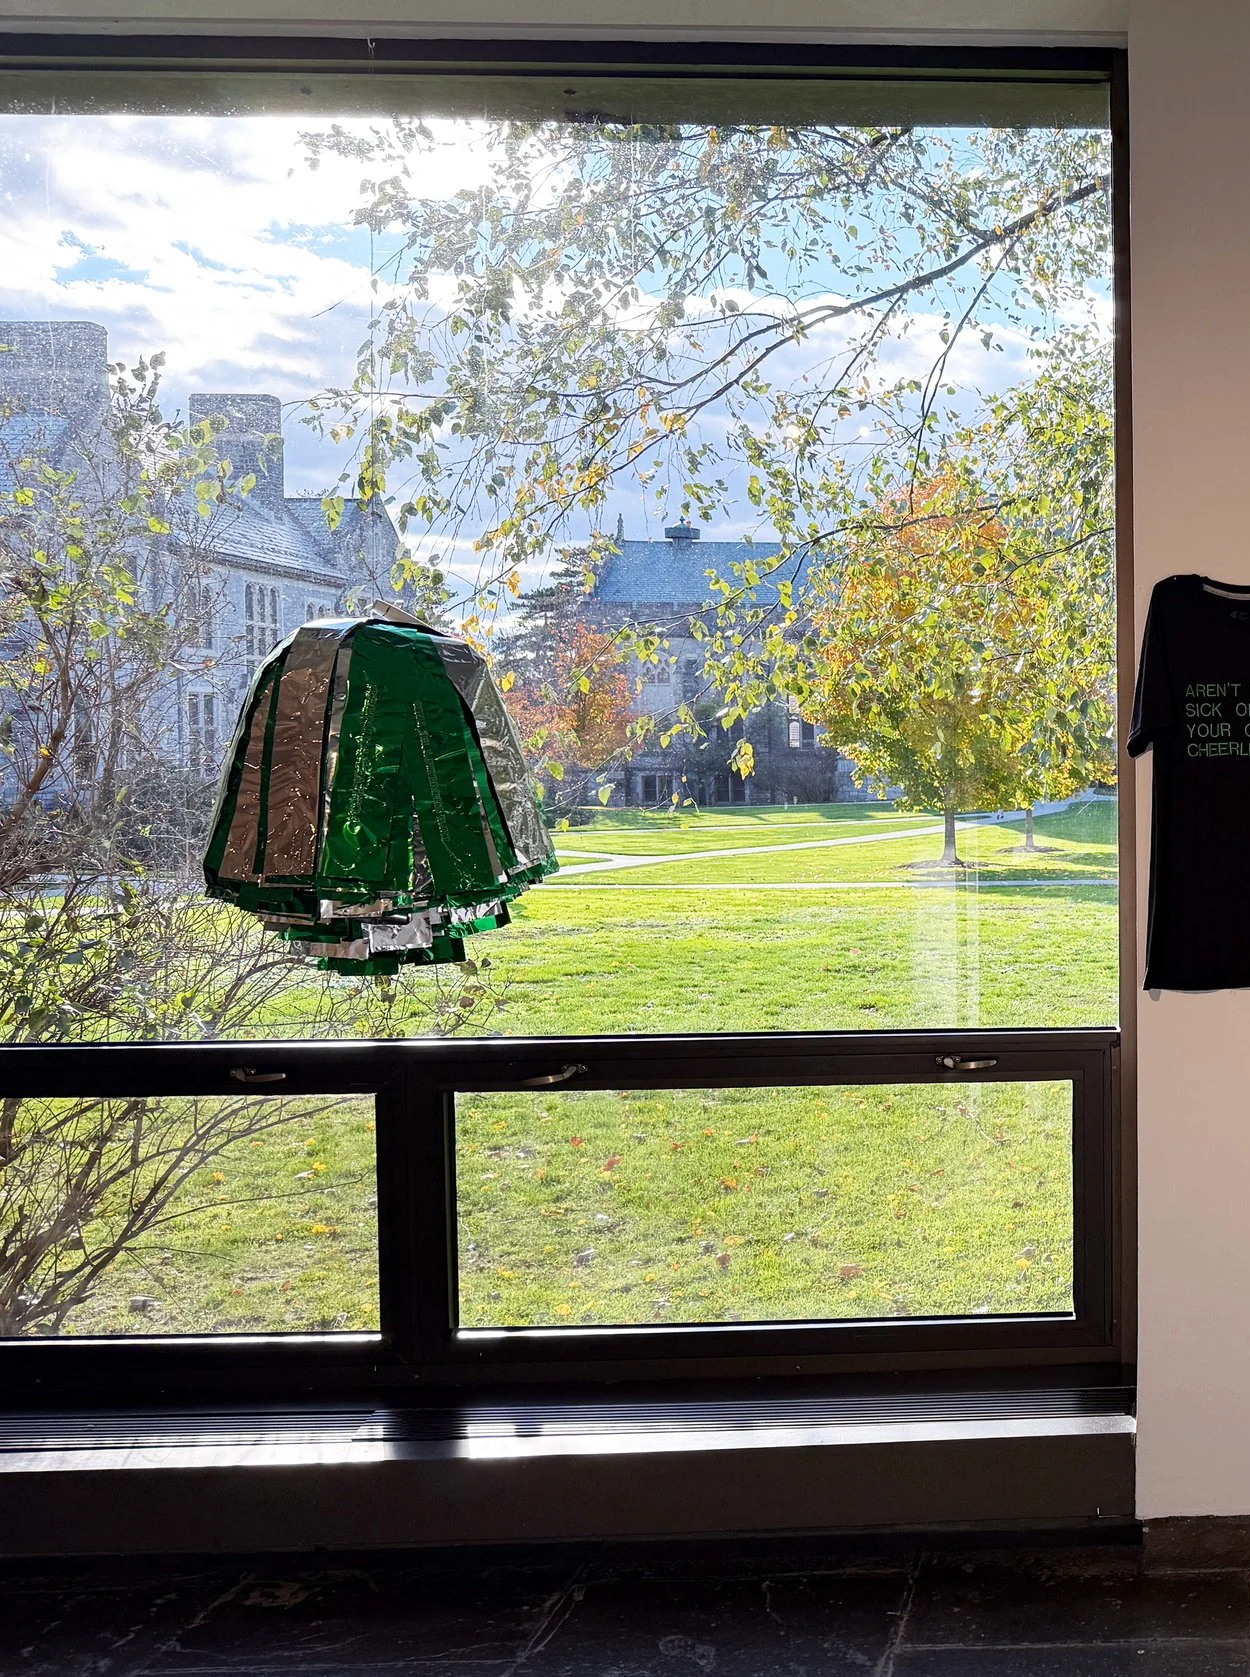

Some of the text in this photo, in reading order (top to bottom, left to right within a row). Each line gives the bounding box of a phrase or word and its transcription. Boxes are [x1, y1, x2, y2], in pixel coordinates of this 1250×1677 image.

[1185, 682, 1242, 697] AREN'T
[1185, 702, 1222, 717] SICK
[1186, 722, 1231, 739] YOUR
